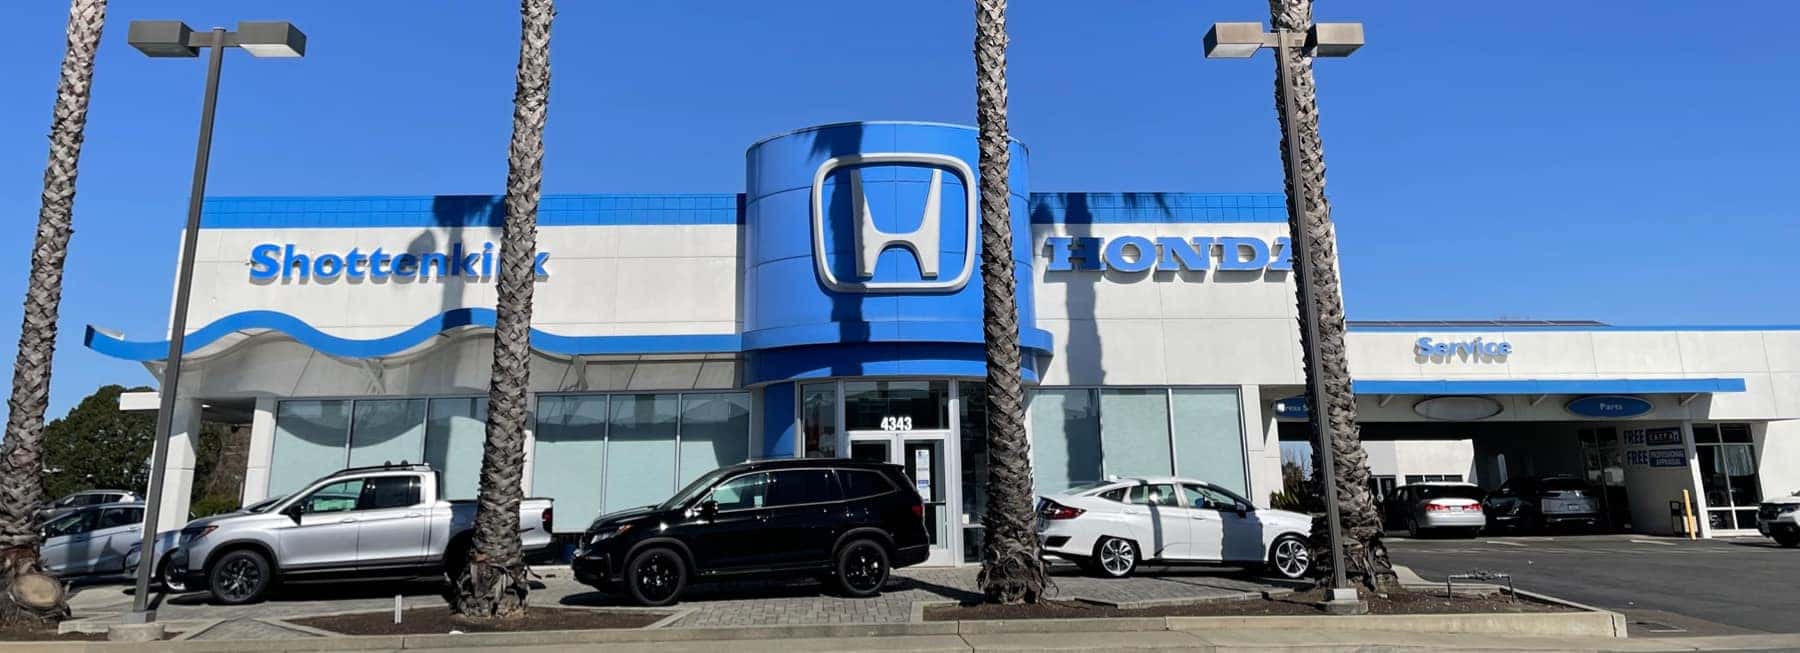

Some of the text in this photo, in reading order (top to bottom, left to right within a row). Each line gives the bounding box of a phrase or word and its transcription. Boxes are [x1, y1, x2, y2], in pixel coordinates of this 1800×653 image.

[250, 243, 550, 278] Shottenkik
[1416, 336, 1512, 356] Service
[1600, 402, 1623, 411] Parts
[881, 416, 912, 430] 4343
[1624, 429, 1644, 445] FREE
[1627, 450, 1648, 465] FREE
